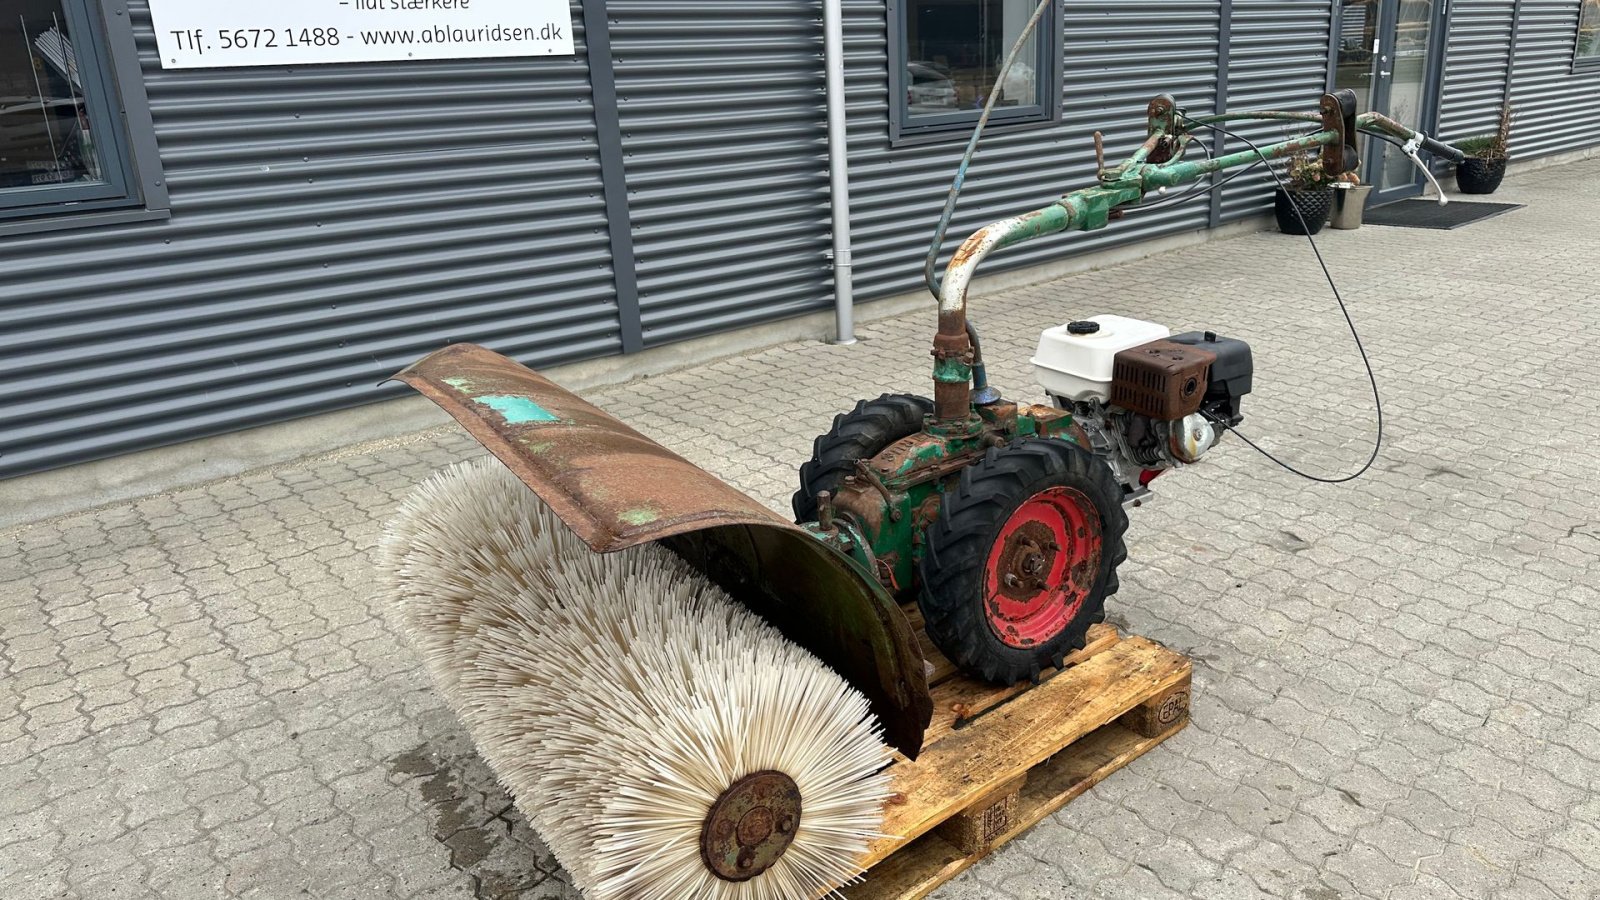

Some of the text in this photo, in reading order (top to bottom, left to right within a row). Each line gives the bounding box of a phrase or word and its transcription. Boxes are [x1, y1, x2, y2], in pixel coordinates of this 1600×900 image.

[170, 29, 212, 55] Tlf.
[218, 29, 279, 49] 5672
[284, 28, 341, 47] 1488
[360, 23, 563, 45] www.ablauridsen.dk
[1162, 696, 1186, 720] EPAL
